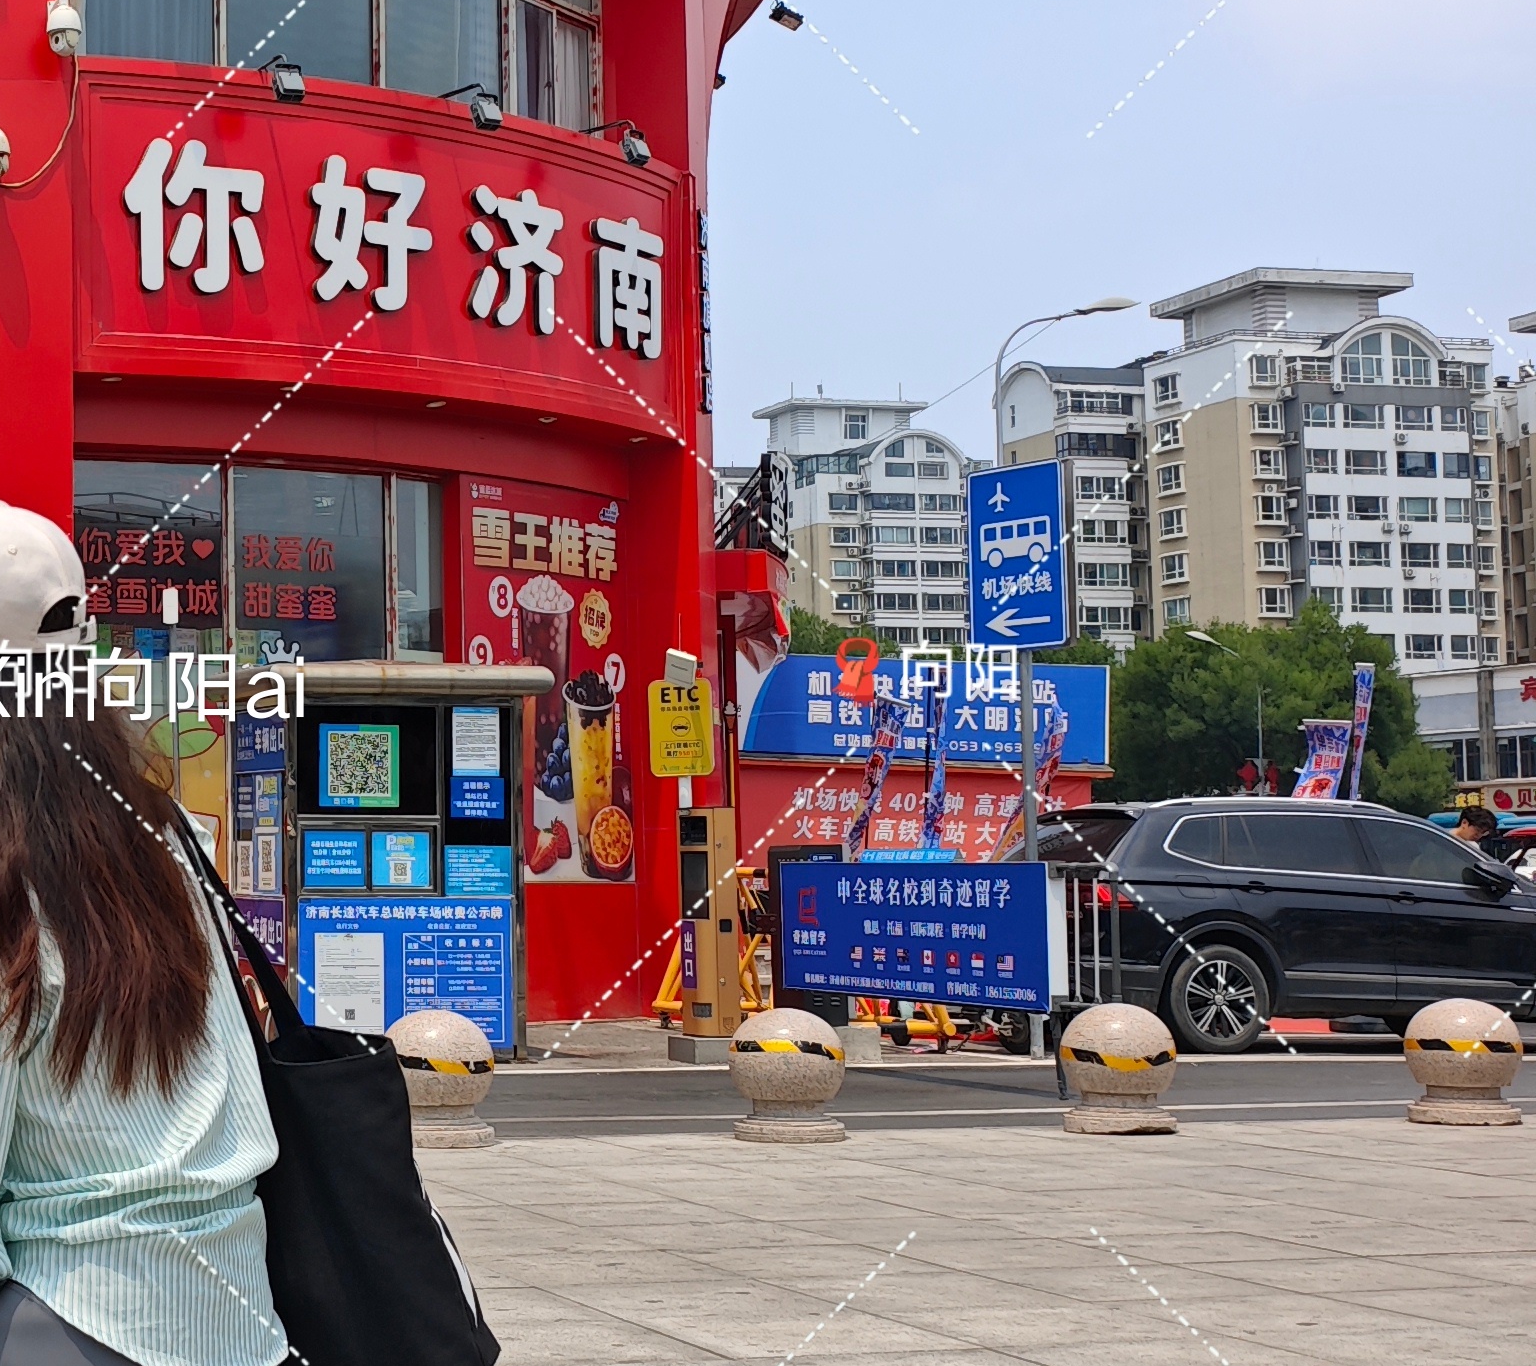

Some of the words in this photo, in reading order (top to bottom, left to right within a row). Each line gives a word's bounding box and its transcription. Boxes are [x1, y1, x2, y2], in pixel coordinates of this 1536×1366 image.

[123, 137, 664, 359] 你好济南
[79, 527, 186, 566] 你爱我
[243, 535, 336, 572] 我爱你
[471, 506, 617, 582] 雪王推荐
[244, 581, 337, 620] 甜蜜蜜
[981, 570, 1053, 601] 机场快线
[583, 604, 606, 631] 招牌
[660, 685, 700, 704] ETC
[807, 670, 924, 701] 机快线
[807, 700, 924, 729] 高铁站
[1517, 788, 1536, 809] 贝
[873, 818, 968, 846] 高铁站
[837, 876, 1012, 909] 申全球名校到奇迹留学
[305, 905, 504, 920] 济南长途汽车总站停车场收费公示牌
[792, 929, 827, 946] 奇迹留学
[683, 931, 694, 978] 出口
